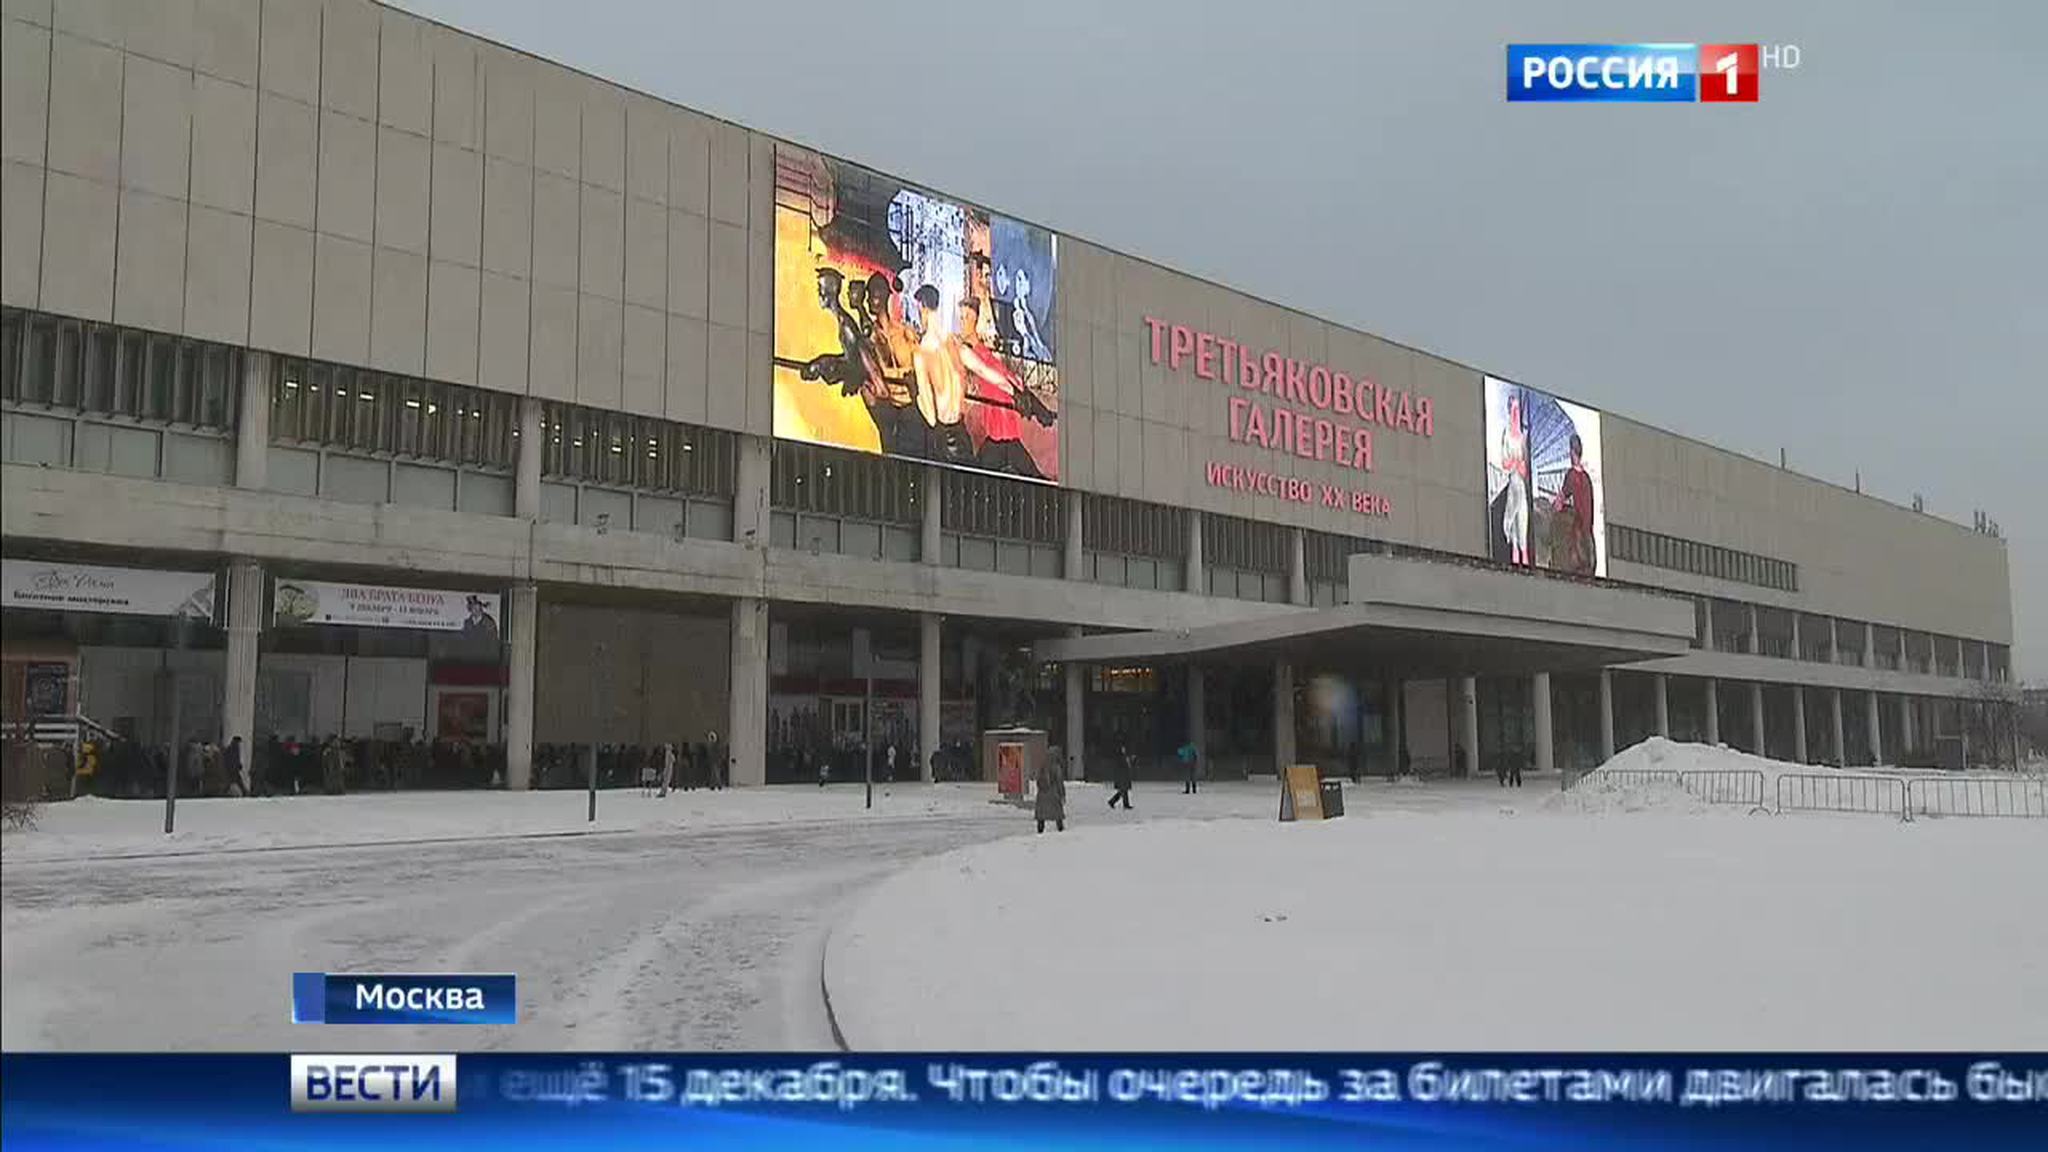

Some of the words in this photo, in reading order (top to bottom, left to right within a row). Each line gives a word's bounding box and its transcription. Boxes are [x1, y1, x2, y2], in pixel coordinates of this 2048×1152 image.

[1144, 316, 1435, 437] ТРЕТЬЯКОВСКАЯ
[1227, 396, 1375, 472] ГАЛЕРЕЯ
[1205, 460, 1313, 502] ИСКУССТВО
[1352, 492, 1392, 518] ВЕКА
